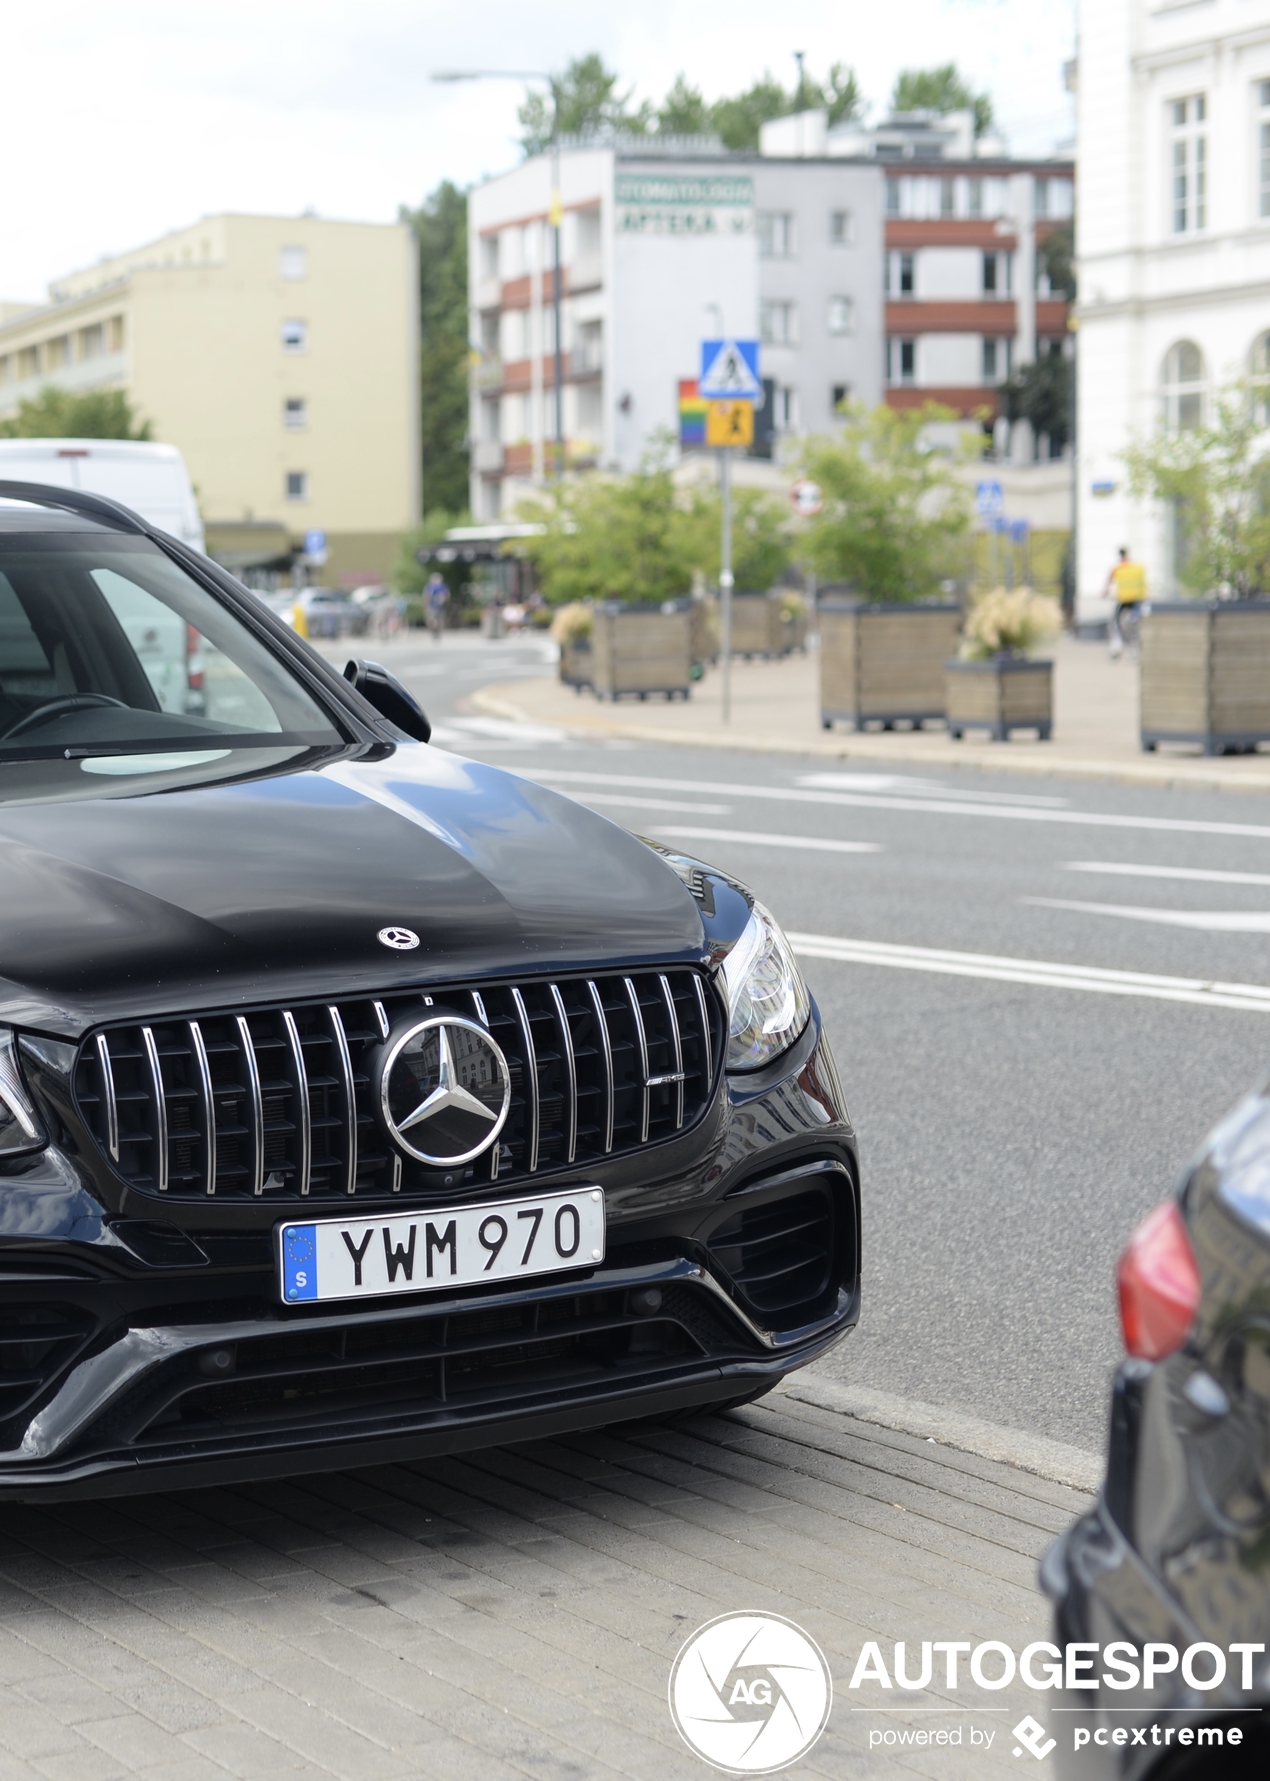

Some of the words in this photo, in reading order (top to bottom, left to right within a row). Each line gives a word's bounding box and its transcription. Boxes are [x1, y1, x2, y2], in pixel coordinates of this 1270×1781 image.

[622, 211, 716, 233] APTEKA
[341, 1220, 457, 1286] YWM
[478, 1204, 580, 1271] 970
[295, 1272, 308, 1287] S
